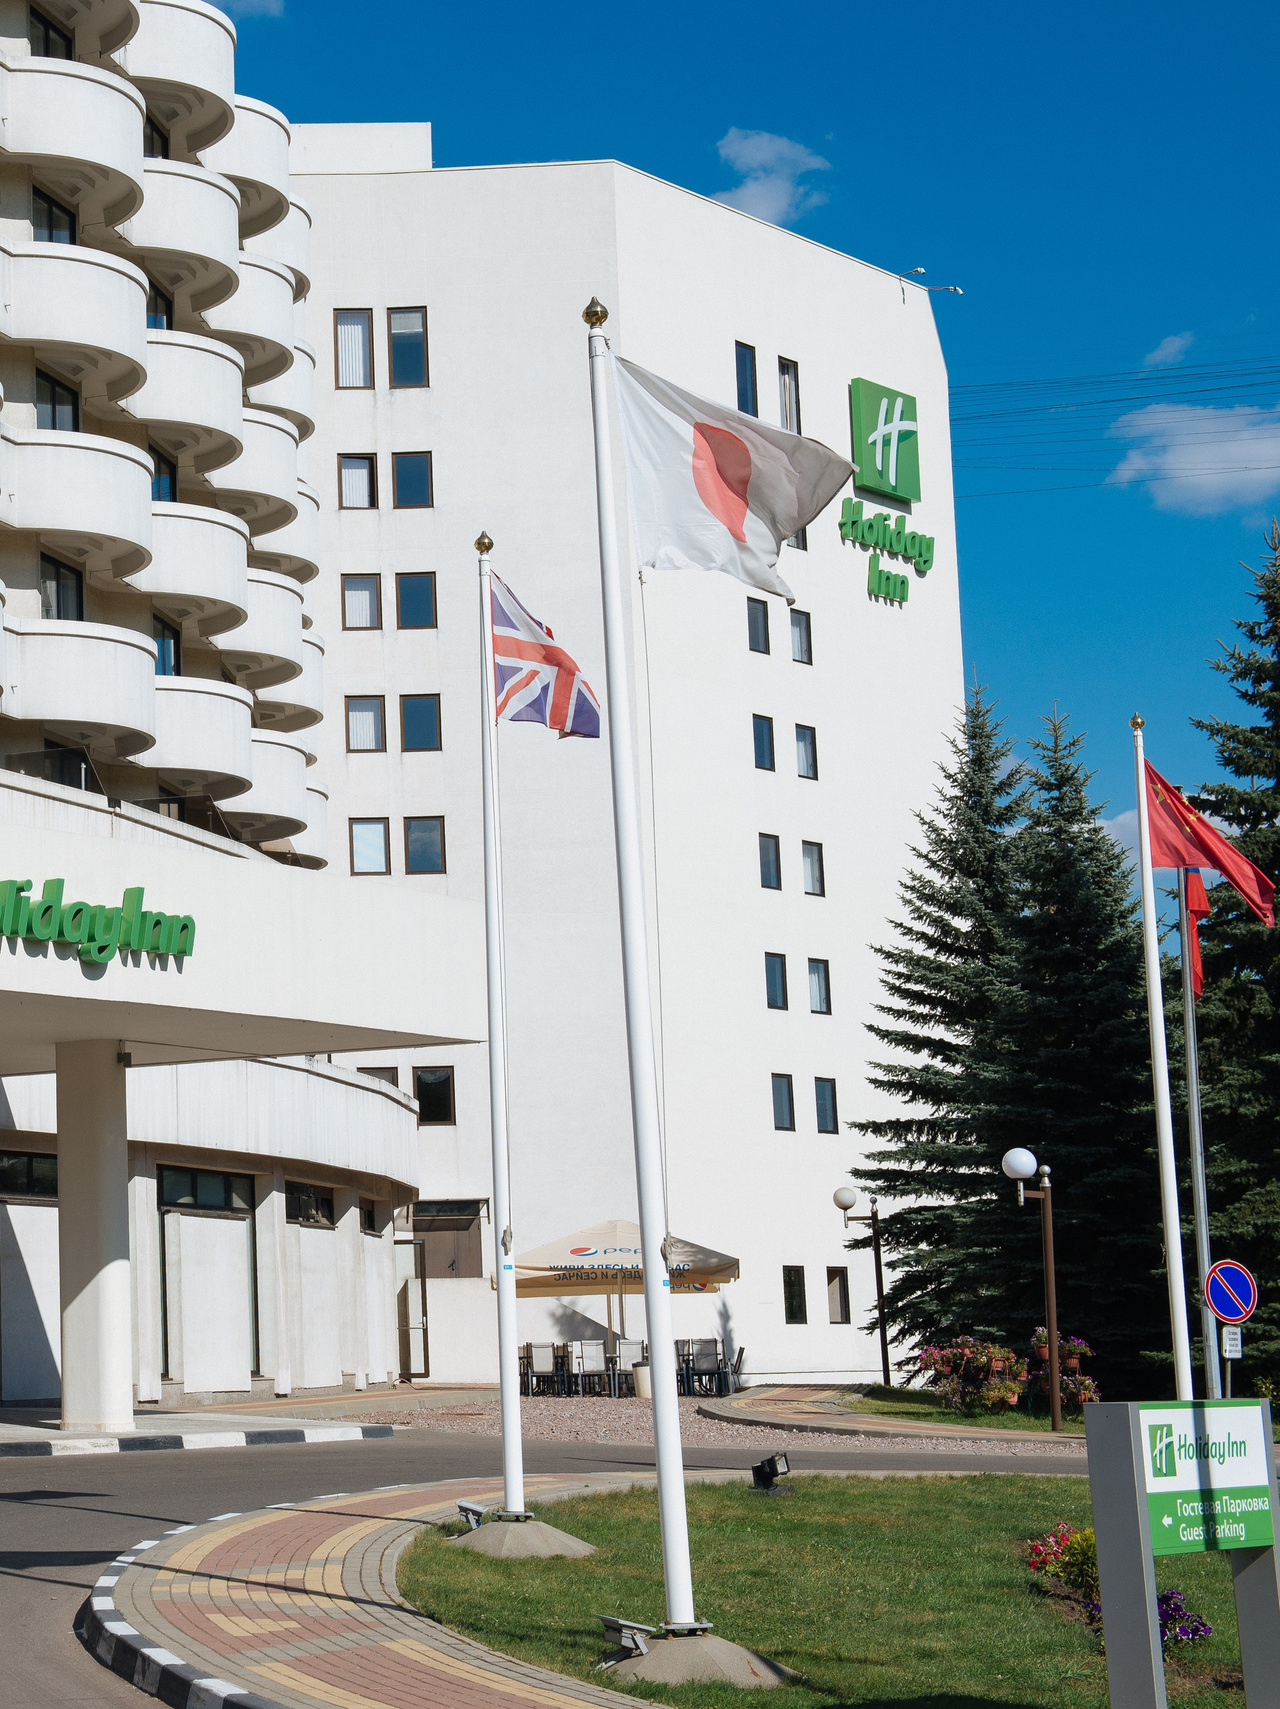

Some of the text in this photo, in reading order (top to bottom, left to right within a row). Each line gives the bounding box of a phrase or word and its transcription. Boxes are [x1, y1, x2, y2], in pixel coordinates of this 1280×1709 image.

[838, 497, 935, 571] Holiday
[867, 553, 909, 602] Inn
[121, 886, 196, 957] Inn
[603, 1247, 642, 1255] pep
[1177, 1432, 1247, 1465] Holiday Inn
[1177, 1496, 1269, 1517] Гостевая Парковка
[1179, 1519, 1245, 1541] Guest Parking
